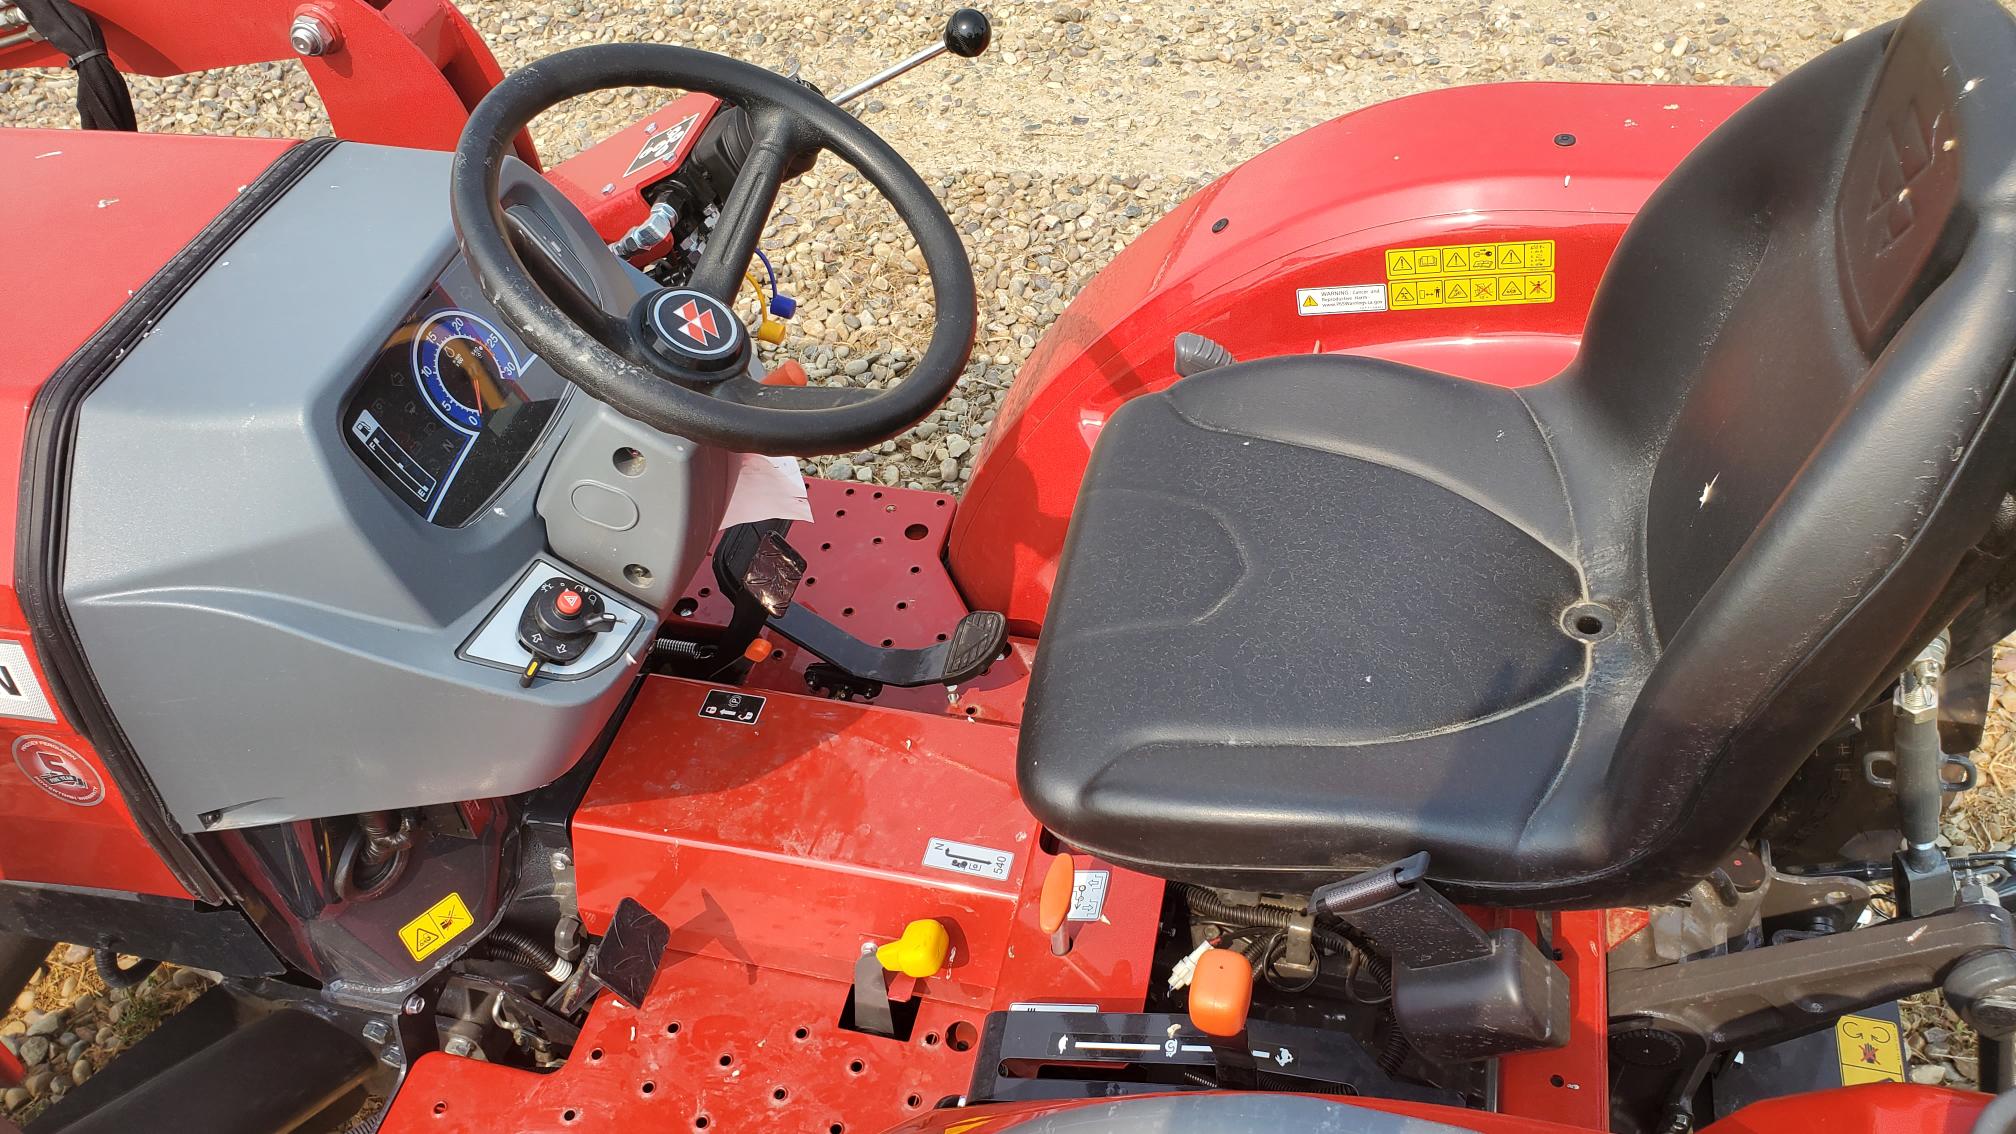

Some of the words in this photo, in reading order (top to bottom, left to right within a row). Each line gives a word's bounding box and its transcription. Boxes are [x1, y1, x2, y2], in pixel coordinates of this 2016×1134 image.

[452, 317, 464, 331] 20
[426, 331, 438, 344] 15
[486, 332, 498, 350] 25
[421, 365, 433, 378] 10
[504, 362, 516, 376] 30
[442, 400, 452, 412] 5
[468, 415, 478, 426] 0
[417, 488, 426, 498] E
[934, 842, 944, 851] N
[993, 856, 1007, 875] 540
